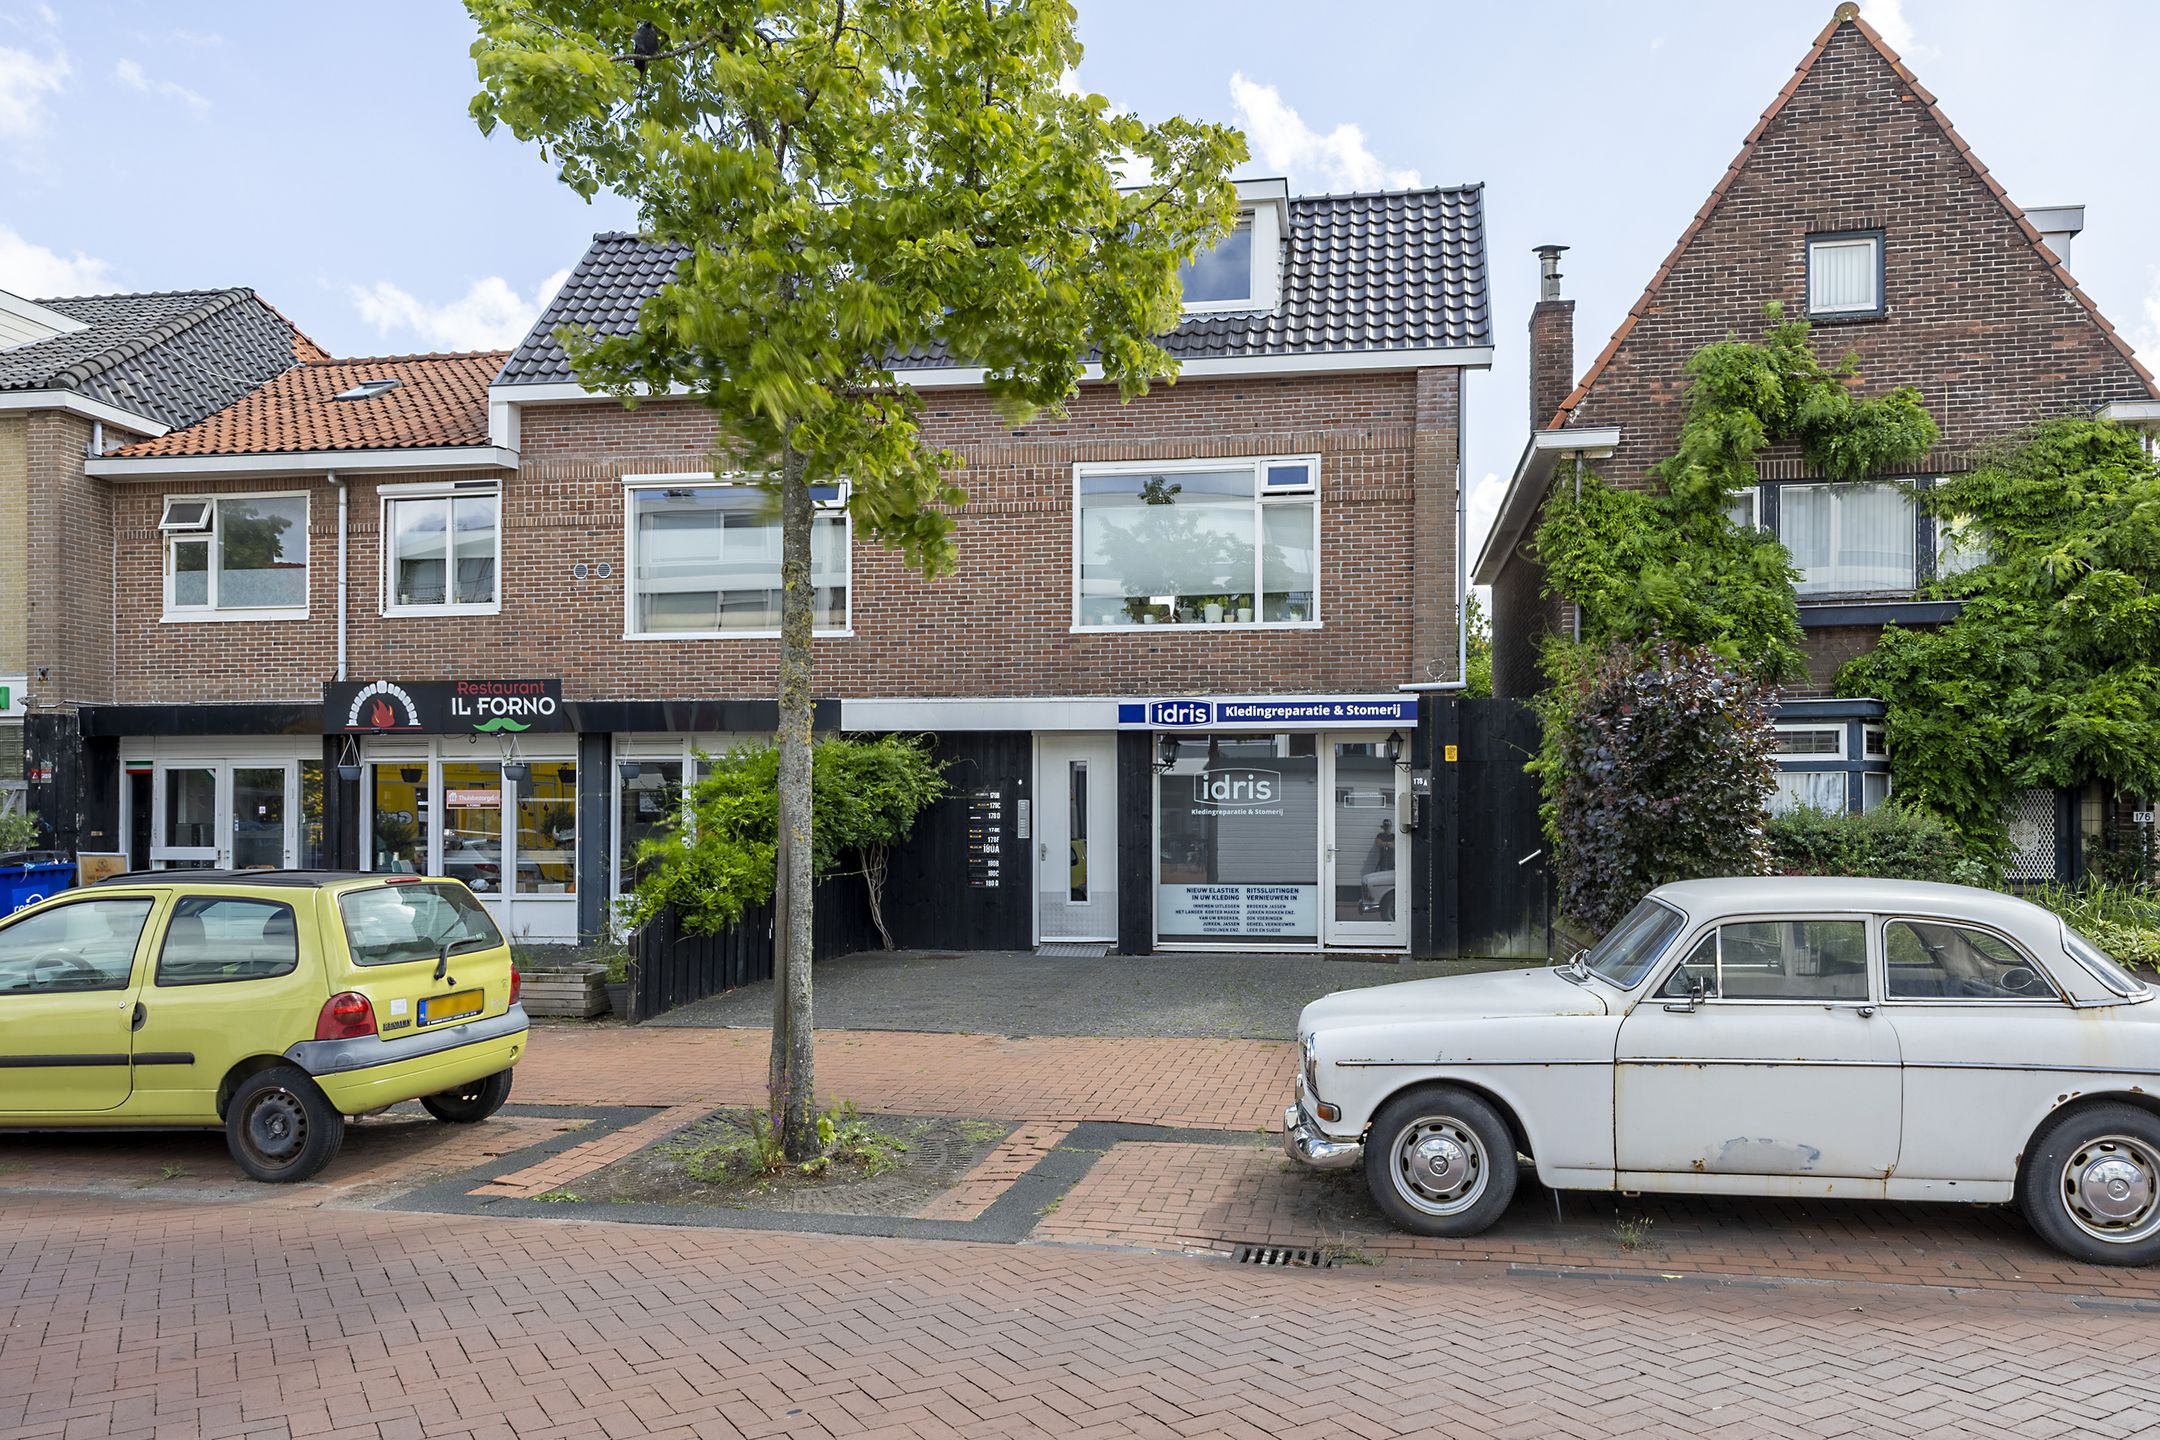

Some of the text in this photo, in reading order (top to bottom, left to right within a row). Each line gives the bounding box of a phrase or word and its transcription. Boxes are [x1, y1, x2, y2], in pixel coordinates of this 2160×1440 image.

[457, 681, 545, 694] Restaurant
[451, 696, 556, 715] IL FORNO
[1157, 704, 1207, 722] idris
[1225, 704, 1401, 719] Kledingreparatie & Stomerij
[1203, 774, 1272, 800] idris
[1191, 808, 1247, 816] Kledingreparatie
[1255, 808, 1284, 816] Stomerij
[2135, 812, 2150, 820] 176
